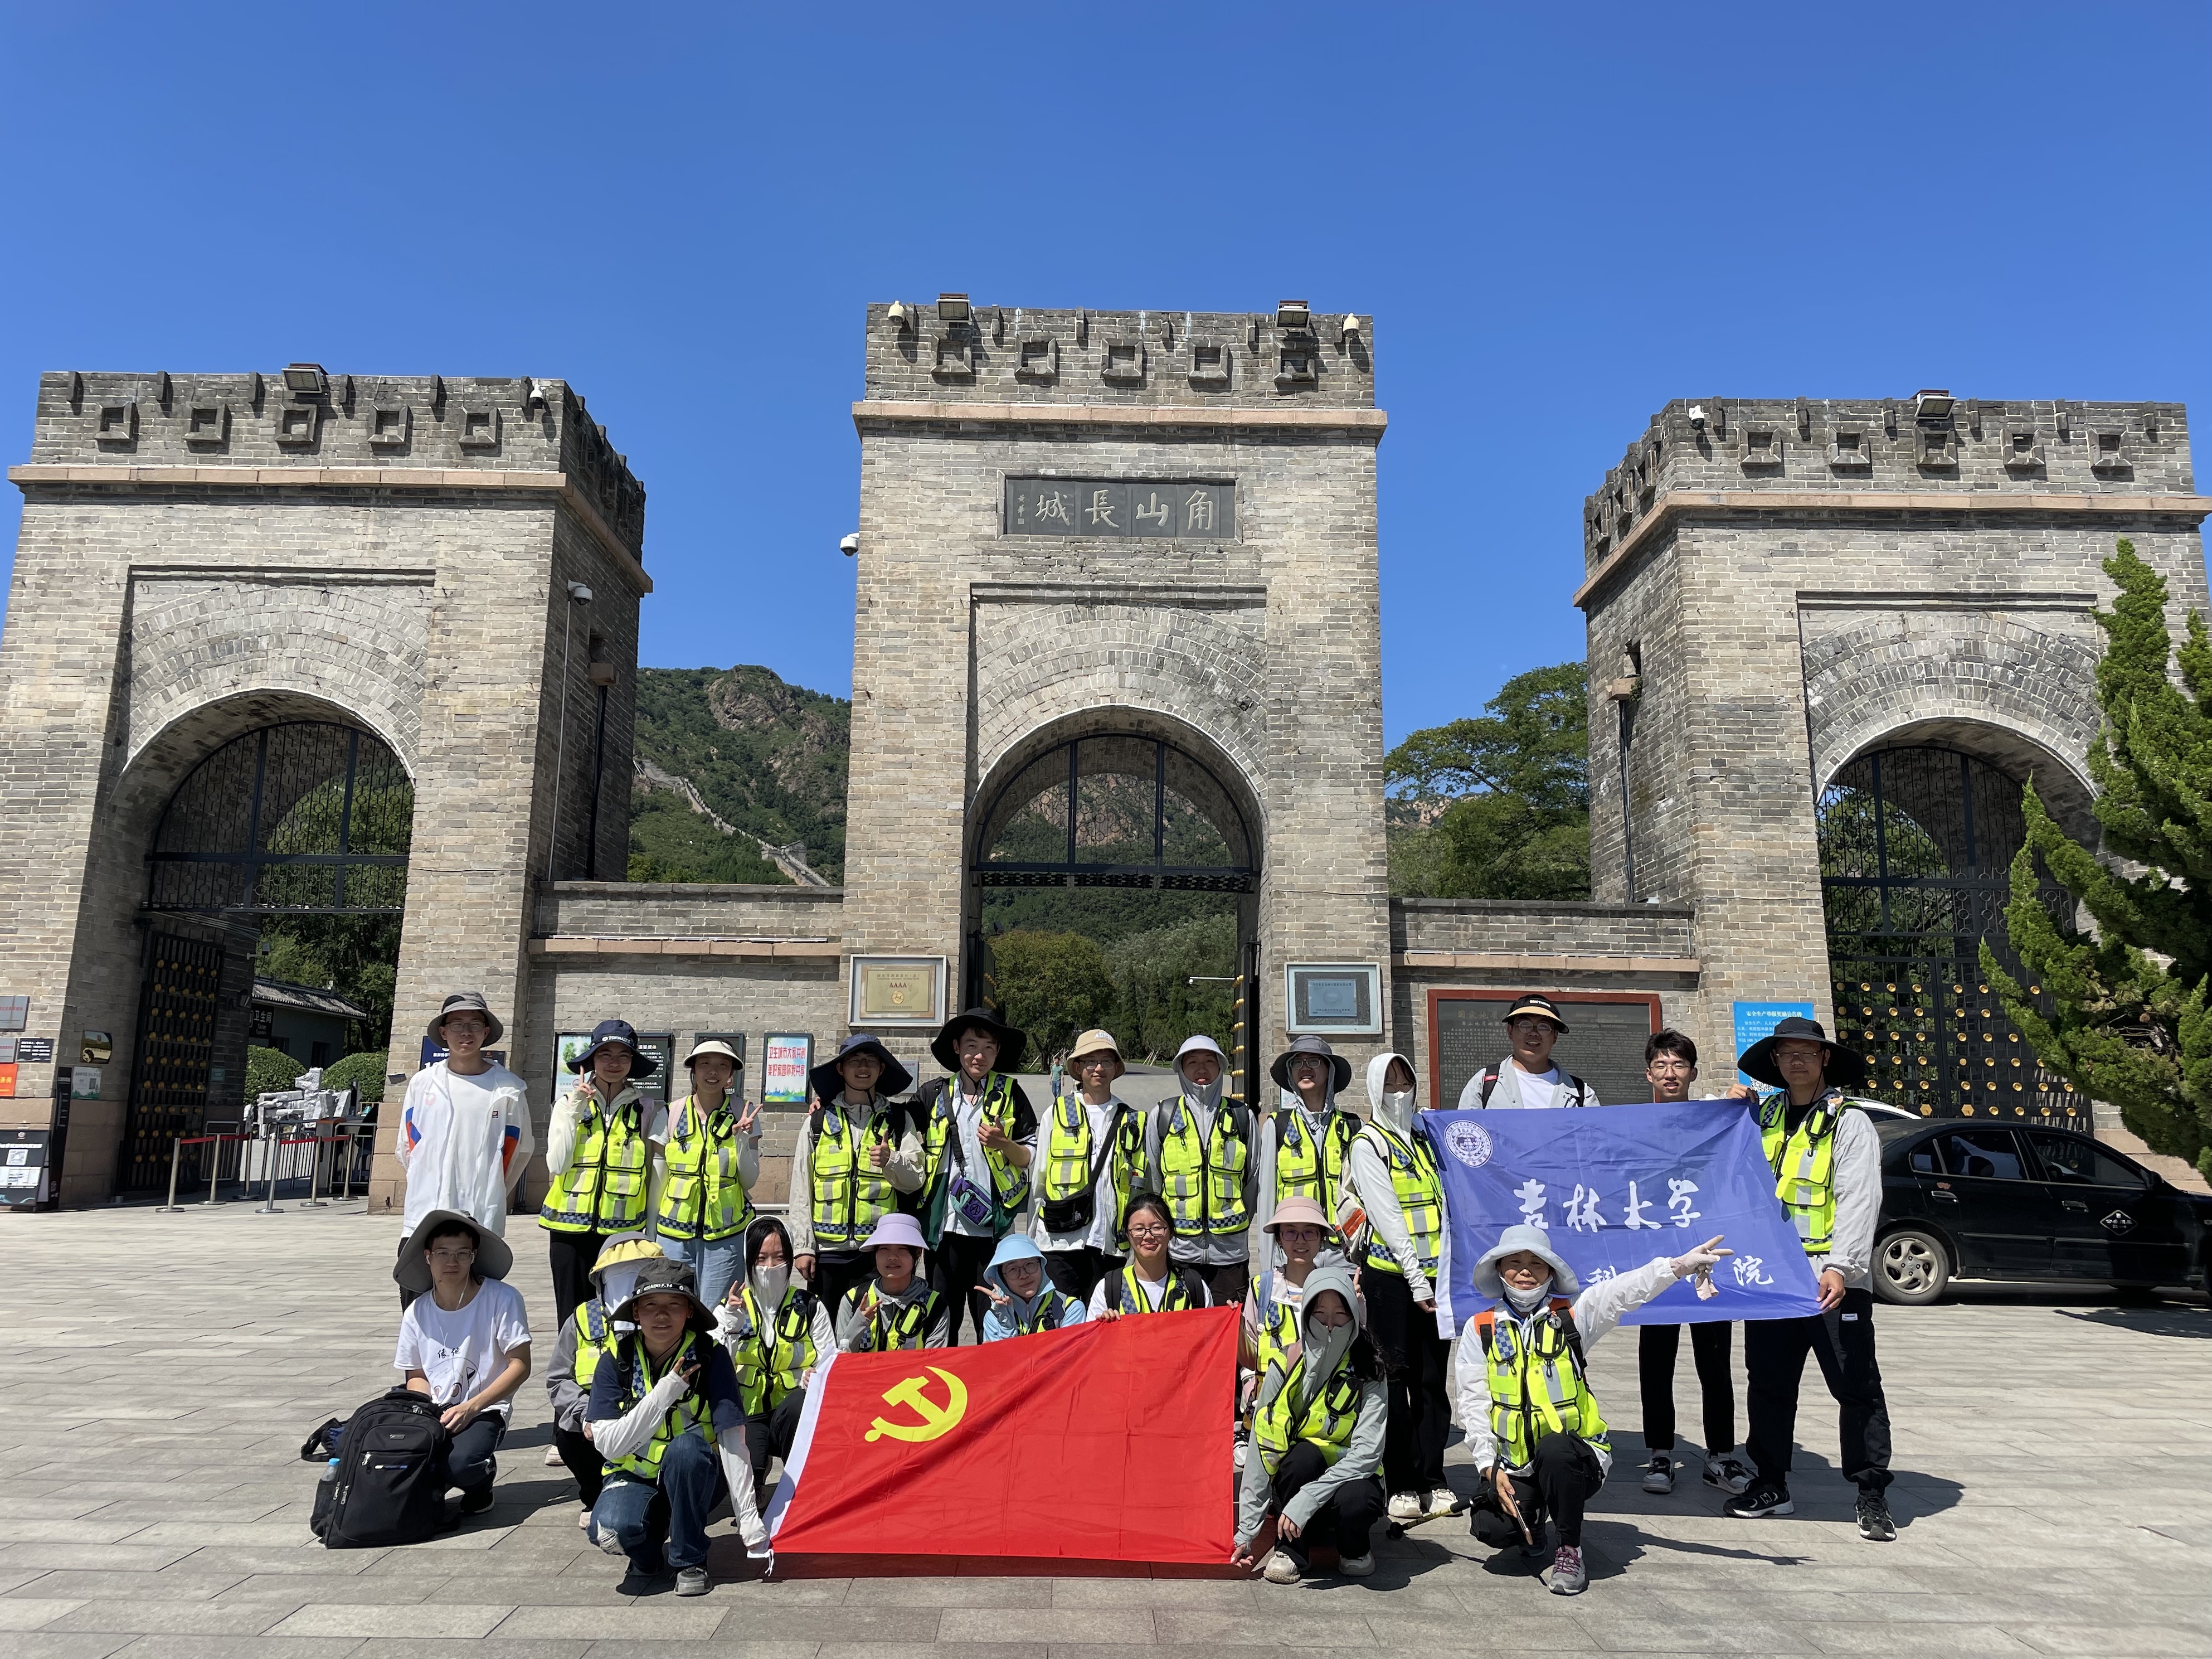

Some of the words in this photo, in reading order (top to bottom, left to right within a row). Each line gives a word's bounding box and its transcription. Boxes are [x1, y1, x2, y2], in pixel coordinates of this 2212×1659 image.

[254, 1010, 272, 1023] 卫生间
[769, 1047, 806, 1059] 卫生城市大家共创
[768, 1064, 805, 1077] 美好家园你我共享
[1513, 1178, 1701, 1233] 吉林大学
